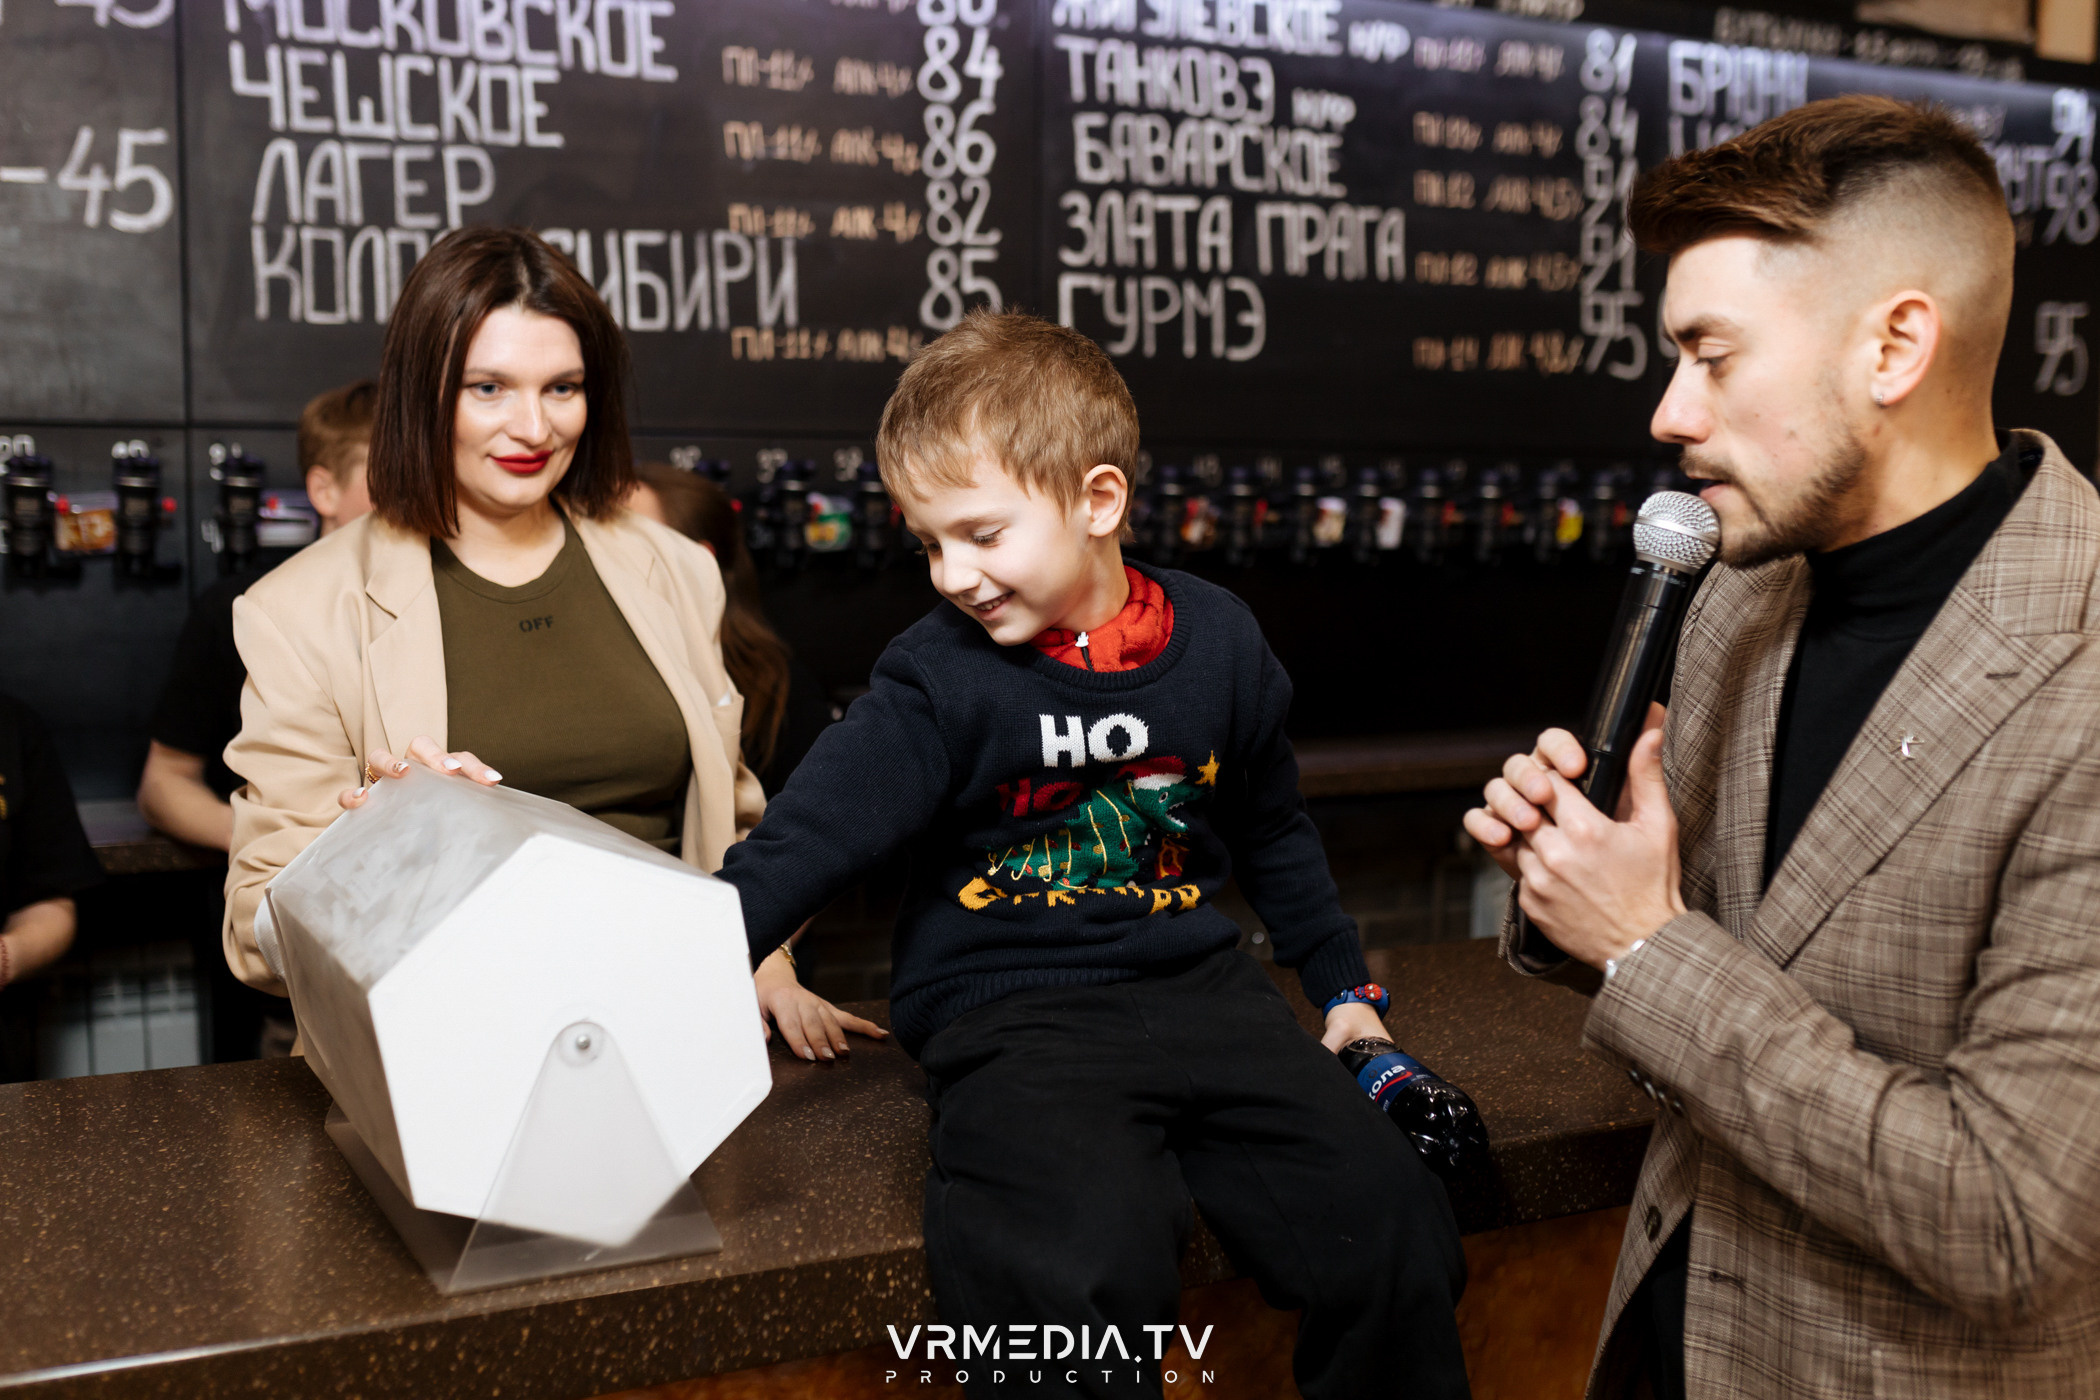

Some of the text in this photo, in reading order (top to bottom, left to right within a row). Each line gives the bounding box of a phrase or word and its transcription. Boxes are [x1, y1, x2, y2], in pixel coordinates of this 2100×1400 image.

[229, 41, 565, 149] ЧЕШСКОЕ
[916, 25, 1004, 102] 84
[252, 138, 496, 230] ЛАГЕР
[921, 99, 997, 179] 86
[1072, 112, 1348, 198] БАВАРСКОЕ
[926, 178, 1003, 247] 82
[1057, 189, 1233, 275] ЗЛАТА
[1254, 203, 1406, 283] ПРАГА
[919, 247, 1003, 332] 85
[1057, 272, 1267, 362] ГУРМЭ
[519, 615, 554, 632] OFF
[1038, 712, 1149, 768] HO
[994, 777, 1084, 818] HO
